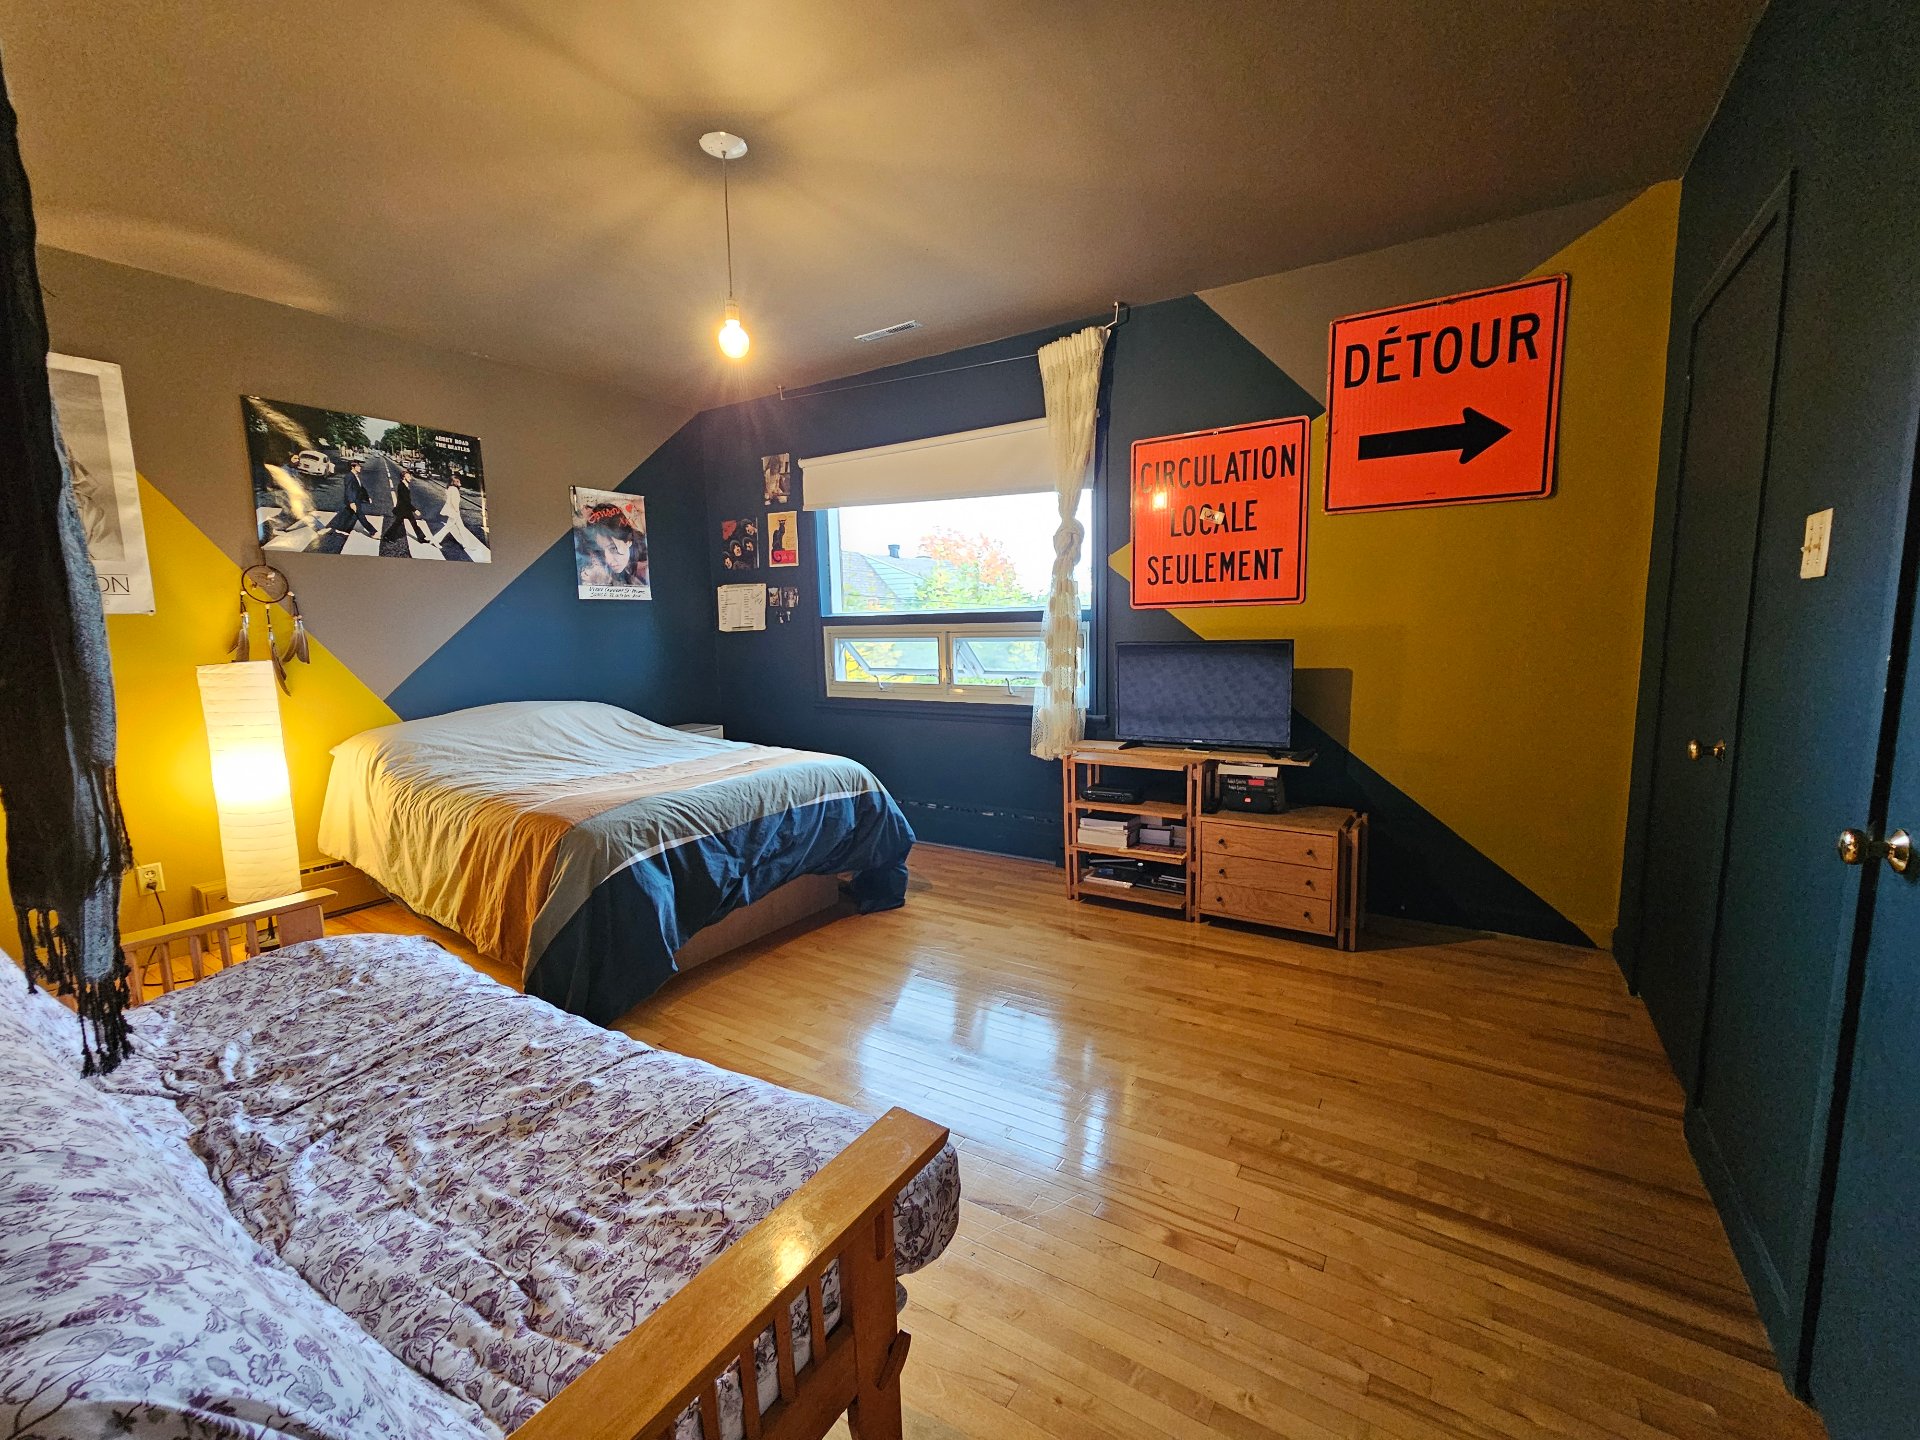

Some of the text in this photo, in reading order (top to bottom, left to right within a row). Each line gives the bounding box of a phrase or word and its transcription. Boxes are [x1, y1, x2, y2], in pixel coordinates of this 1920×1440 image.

[1344, 312, 1541, 389] DÉTOUR
[447, 444, 471, 452] BEATLES
[1140, 443, 1296, 493] CIRCULATION
[1170, 499, 1258, 537] LOCALE
[1147, 547, 1284, 586] SEULEMENT
